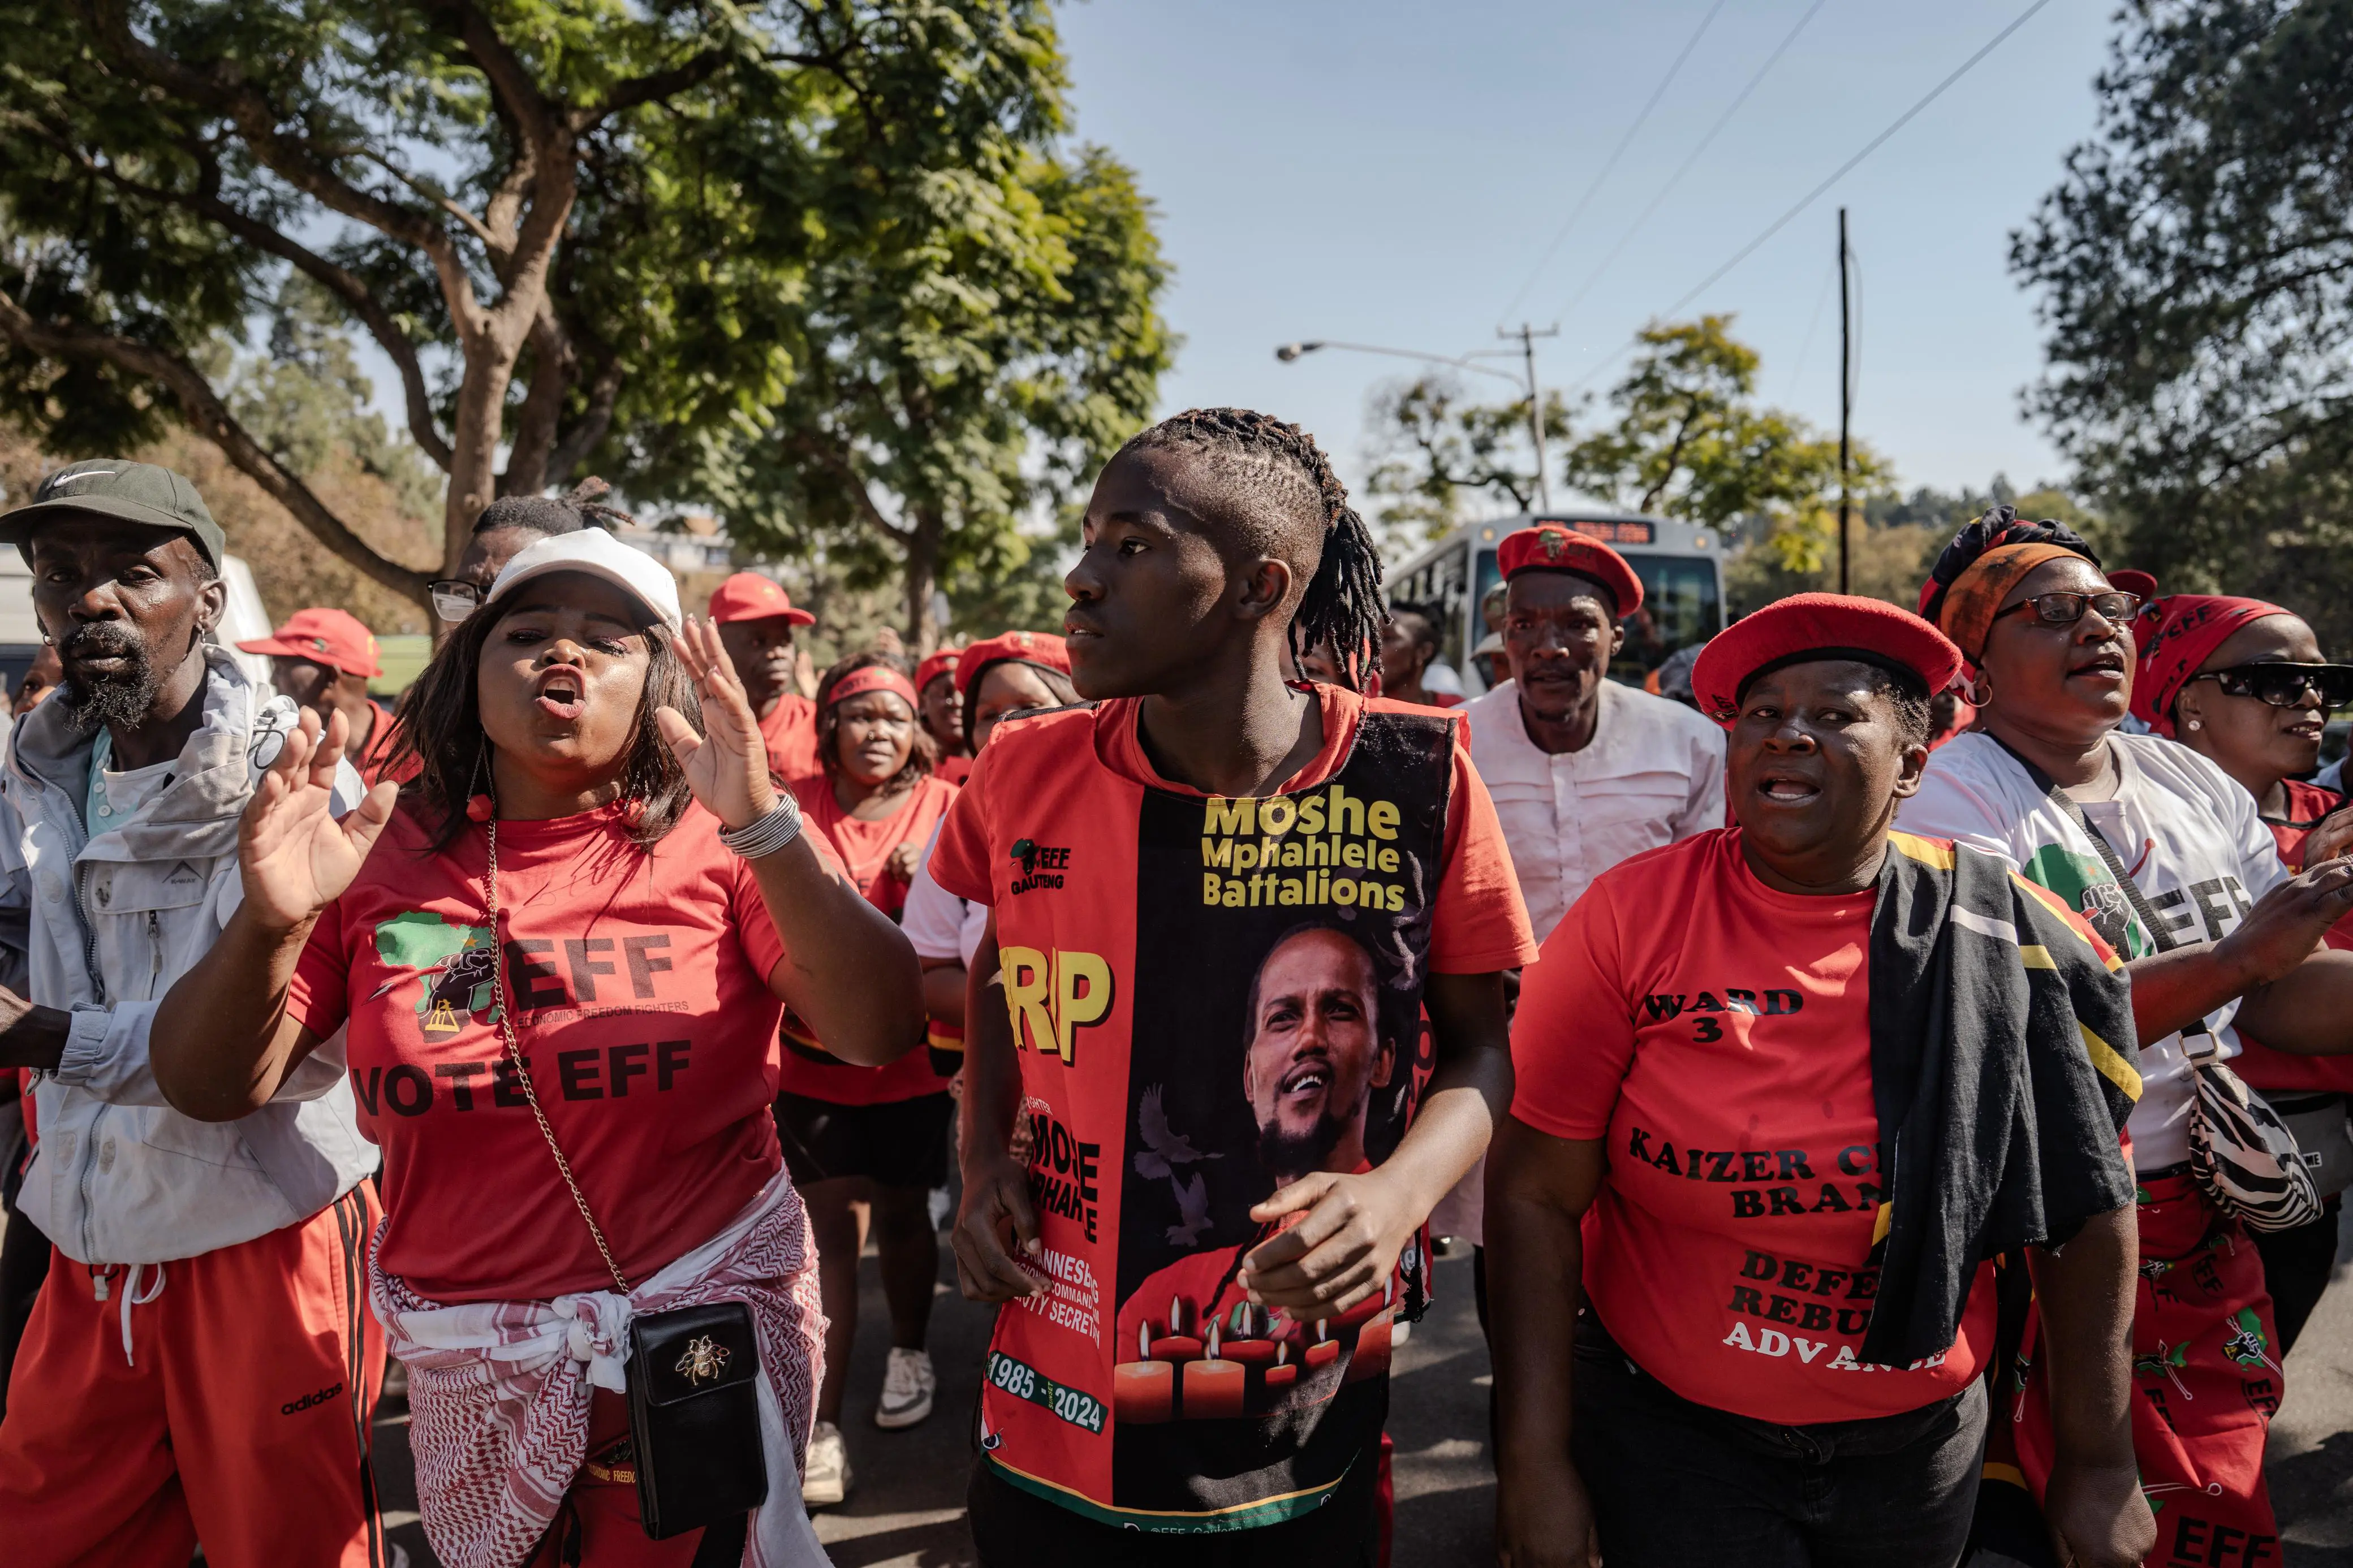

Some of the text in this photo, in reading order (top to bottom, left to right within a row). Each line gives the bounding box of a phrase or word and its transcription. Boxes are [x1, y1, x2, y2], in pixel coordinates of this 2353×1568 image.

[1203, 784, 1400, 840] Moshe
[1201, 835, 1400, 876] Mphahlele
[1011, 874, 1065, 895] GAUTENG
[1204, 868, 1405, 912] Battalions
[503, 934, 673, 1012] EFF
[518, 1001, 689, 1029] ECONOMIC FREEDOM FIGHTERS
[999, 946, 1115, 1068] RP
[1645, 988, 1804, 1021] WARD
[1692, 1017, 1723, 1043] 3
[352, 1040, 692, 1117] VOTE EFF
[1025, 1096, 1053, 1116] IGHTER
[1629, 1127, 1815, 1182] KAIZER
[281, 1383, 343, 1415] adidas
[989, 1353, 1035, 1399] 1985
[1054, 1388, 1100, 1432] 2024
[2173, 1515, 2276, 1568] EFF
